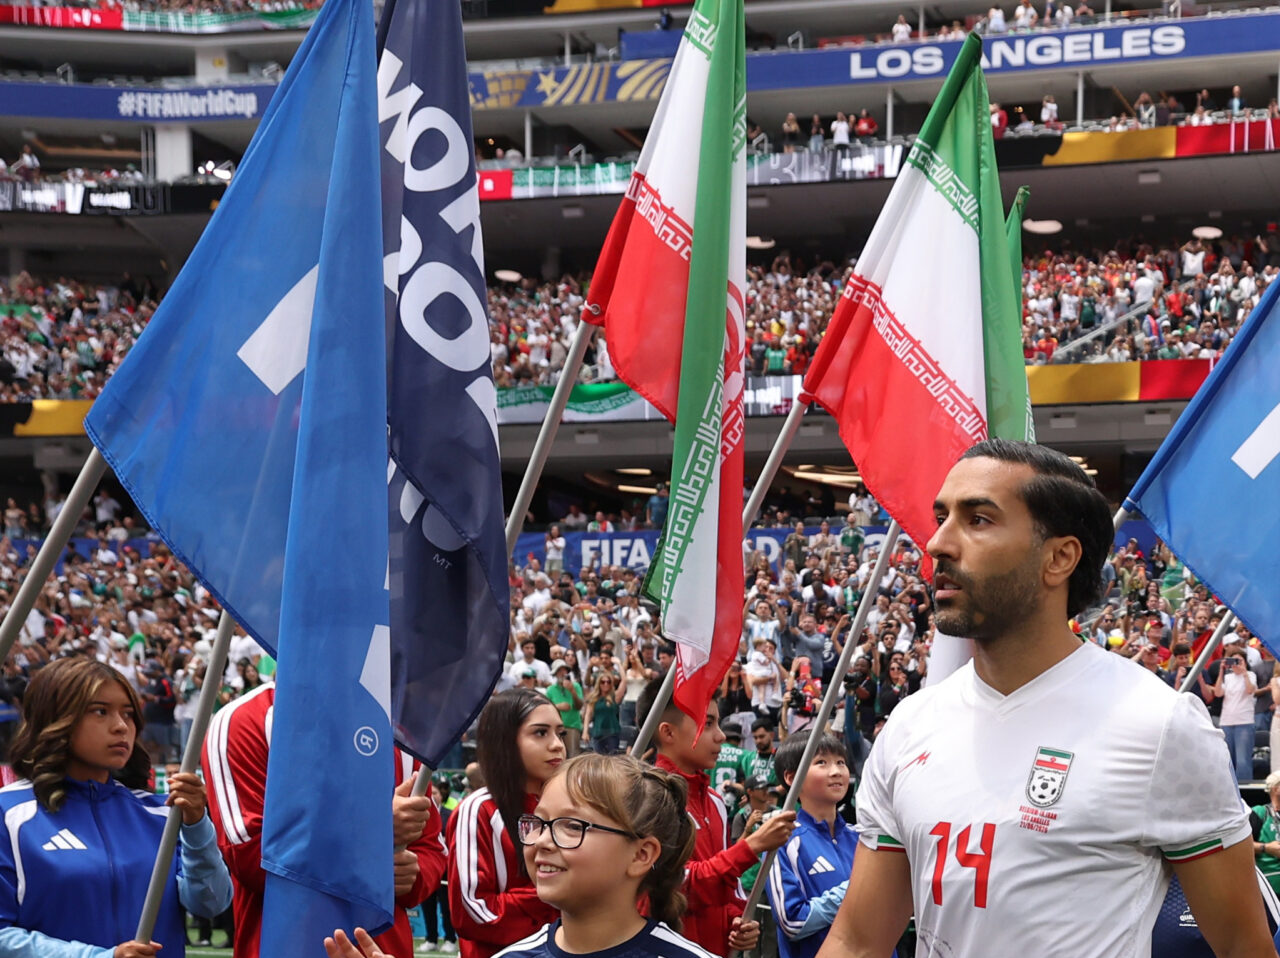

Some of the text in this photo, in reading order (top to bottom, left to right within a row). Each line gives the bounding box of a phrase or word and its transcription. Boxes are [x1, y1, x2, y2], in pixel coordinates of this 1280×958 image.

[850, 46, 944, 80] LOS
[117, 91, 258, 118] #FIFAWorldCup
[581, 538, 650, 569] FIFA
[929, 821, 997, 909] 14
